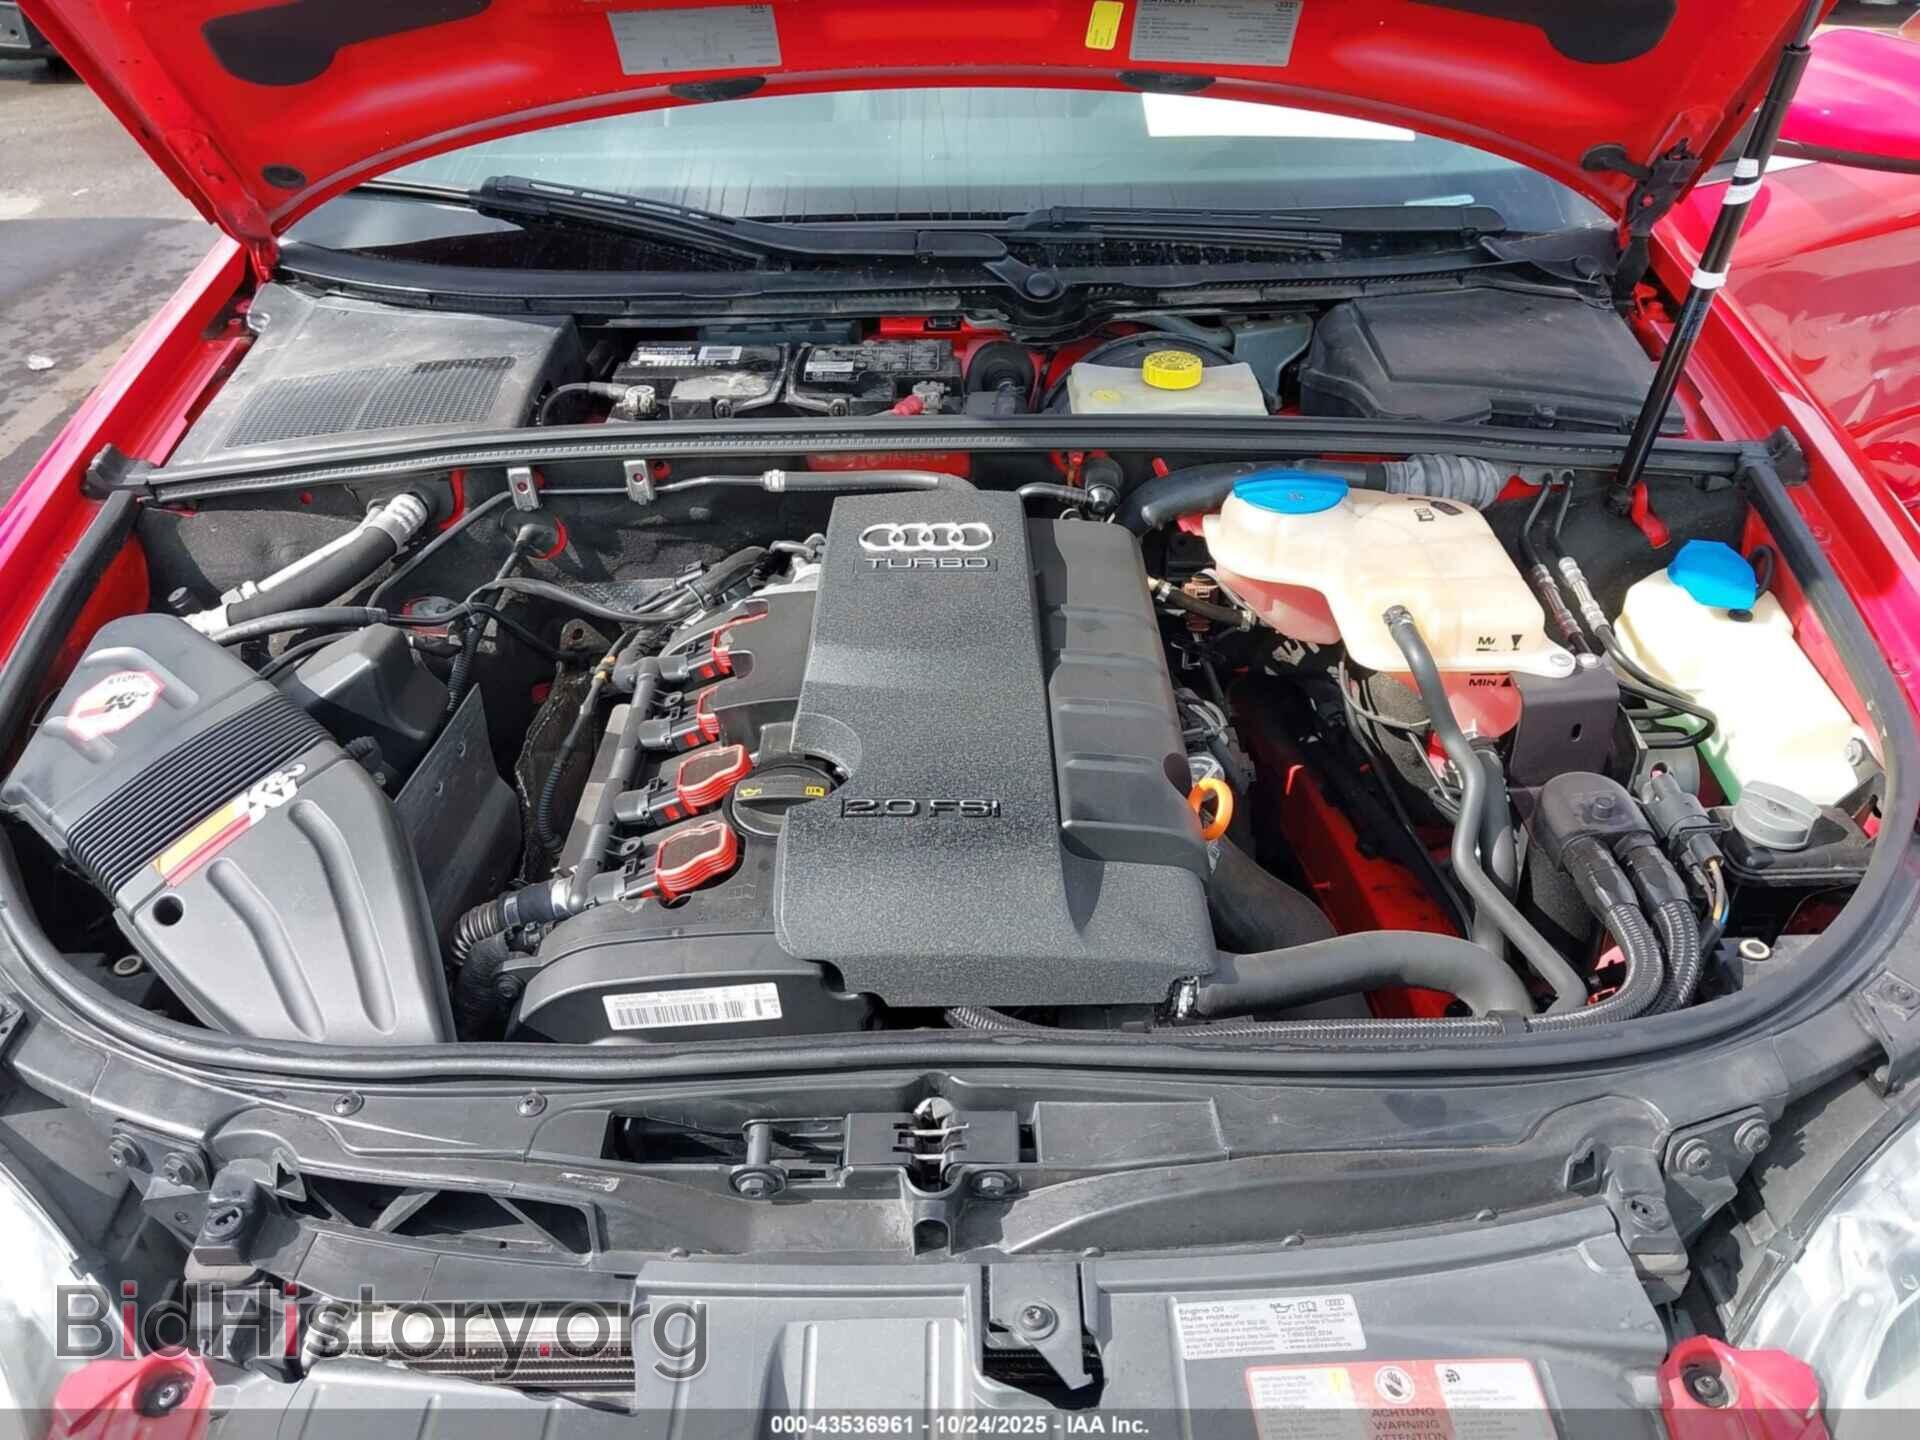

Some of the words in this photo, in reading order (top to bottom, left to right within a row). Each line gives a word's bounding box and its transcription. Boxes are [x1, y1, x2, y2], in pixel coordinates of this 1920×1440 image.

[865, 558, 988, 569] TURBO
[1468, 679, 1497, 687] MIN
[1178, 1308, 1210, 1317] Engine
[1371, 1408, 1436, 1417] ACHTUNG
[1372, 1420, 1441, 1430] WARNING
